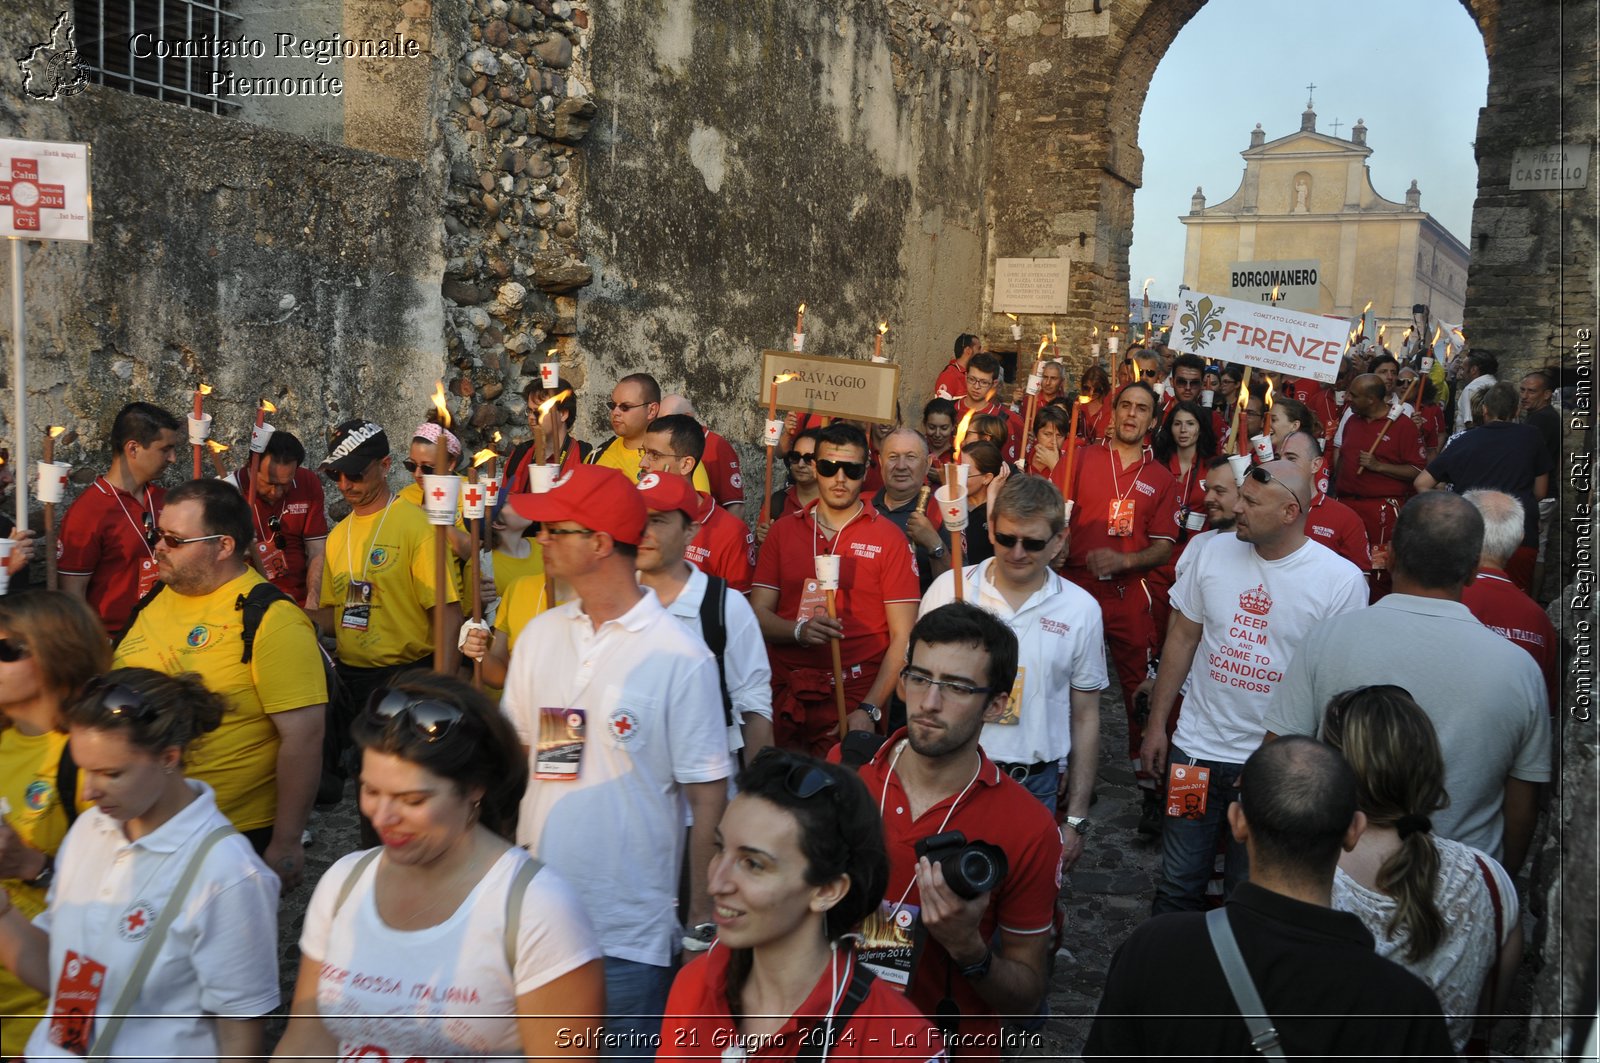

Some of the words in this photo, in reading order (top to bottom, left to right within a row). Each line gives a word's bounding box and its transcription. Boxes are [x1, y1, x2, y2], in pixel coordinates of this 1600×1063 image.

[1533, 153, 1568, 163] PIAZZA
[12, 170, 38, 180] Calm
[40, 195, 63, 204] 2014
[1232, 268, 1317, 288] BORGOMANERO
[1253, 311, 1284, 323] COMITATO
[1285, 318, 1307, 328] LOCALE
[1222, 321, 1341, 364] FIRENZE
[805, 388, 838, 401] ITALY
[1233, 613, 1268, 630] KEEP
[1229, 627, 1267, 646] CALM
[1238, 642, 1253, 650] AND
[1220, 645, 1251, 662] COME
[1254, 654, 1270, 665] TO
[1209, 653, 1283, 683] SCANDICCI
[1209, 669, 1228, 683] RED
[1230, 677, 1271, 694] CROSS
[886, 949, 912, 958] 2014
[351, 972, 402, 994] ROSSA
[409, 983, 480, 1004] ITALIANA
